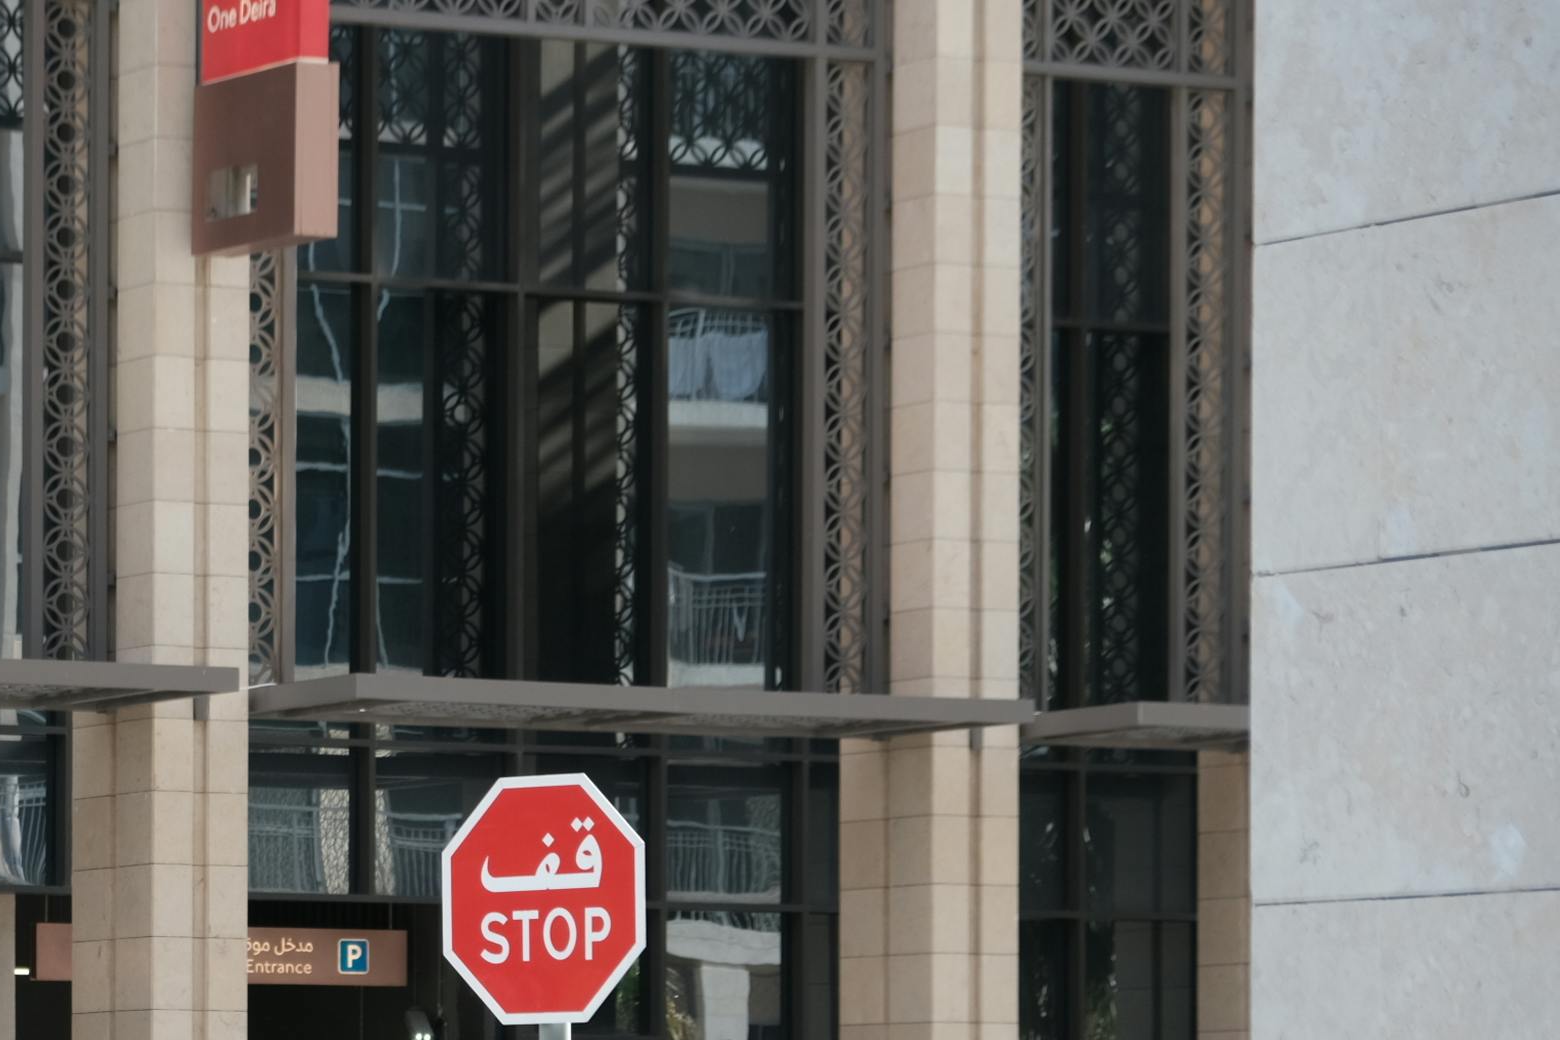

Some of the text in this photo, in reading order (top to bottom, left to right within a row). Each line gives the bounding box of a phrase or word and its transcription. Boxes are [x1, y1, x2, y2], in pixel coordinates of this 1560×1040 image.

[207, 5, 238, 34] One
[480, 816, 603, 893] قف
[274, 937, 314, 956] مدخل
[480, 906, 612, 965] STOP
[247, 959, 314, 975] Entrance
[347, 944, 364, 969] P
